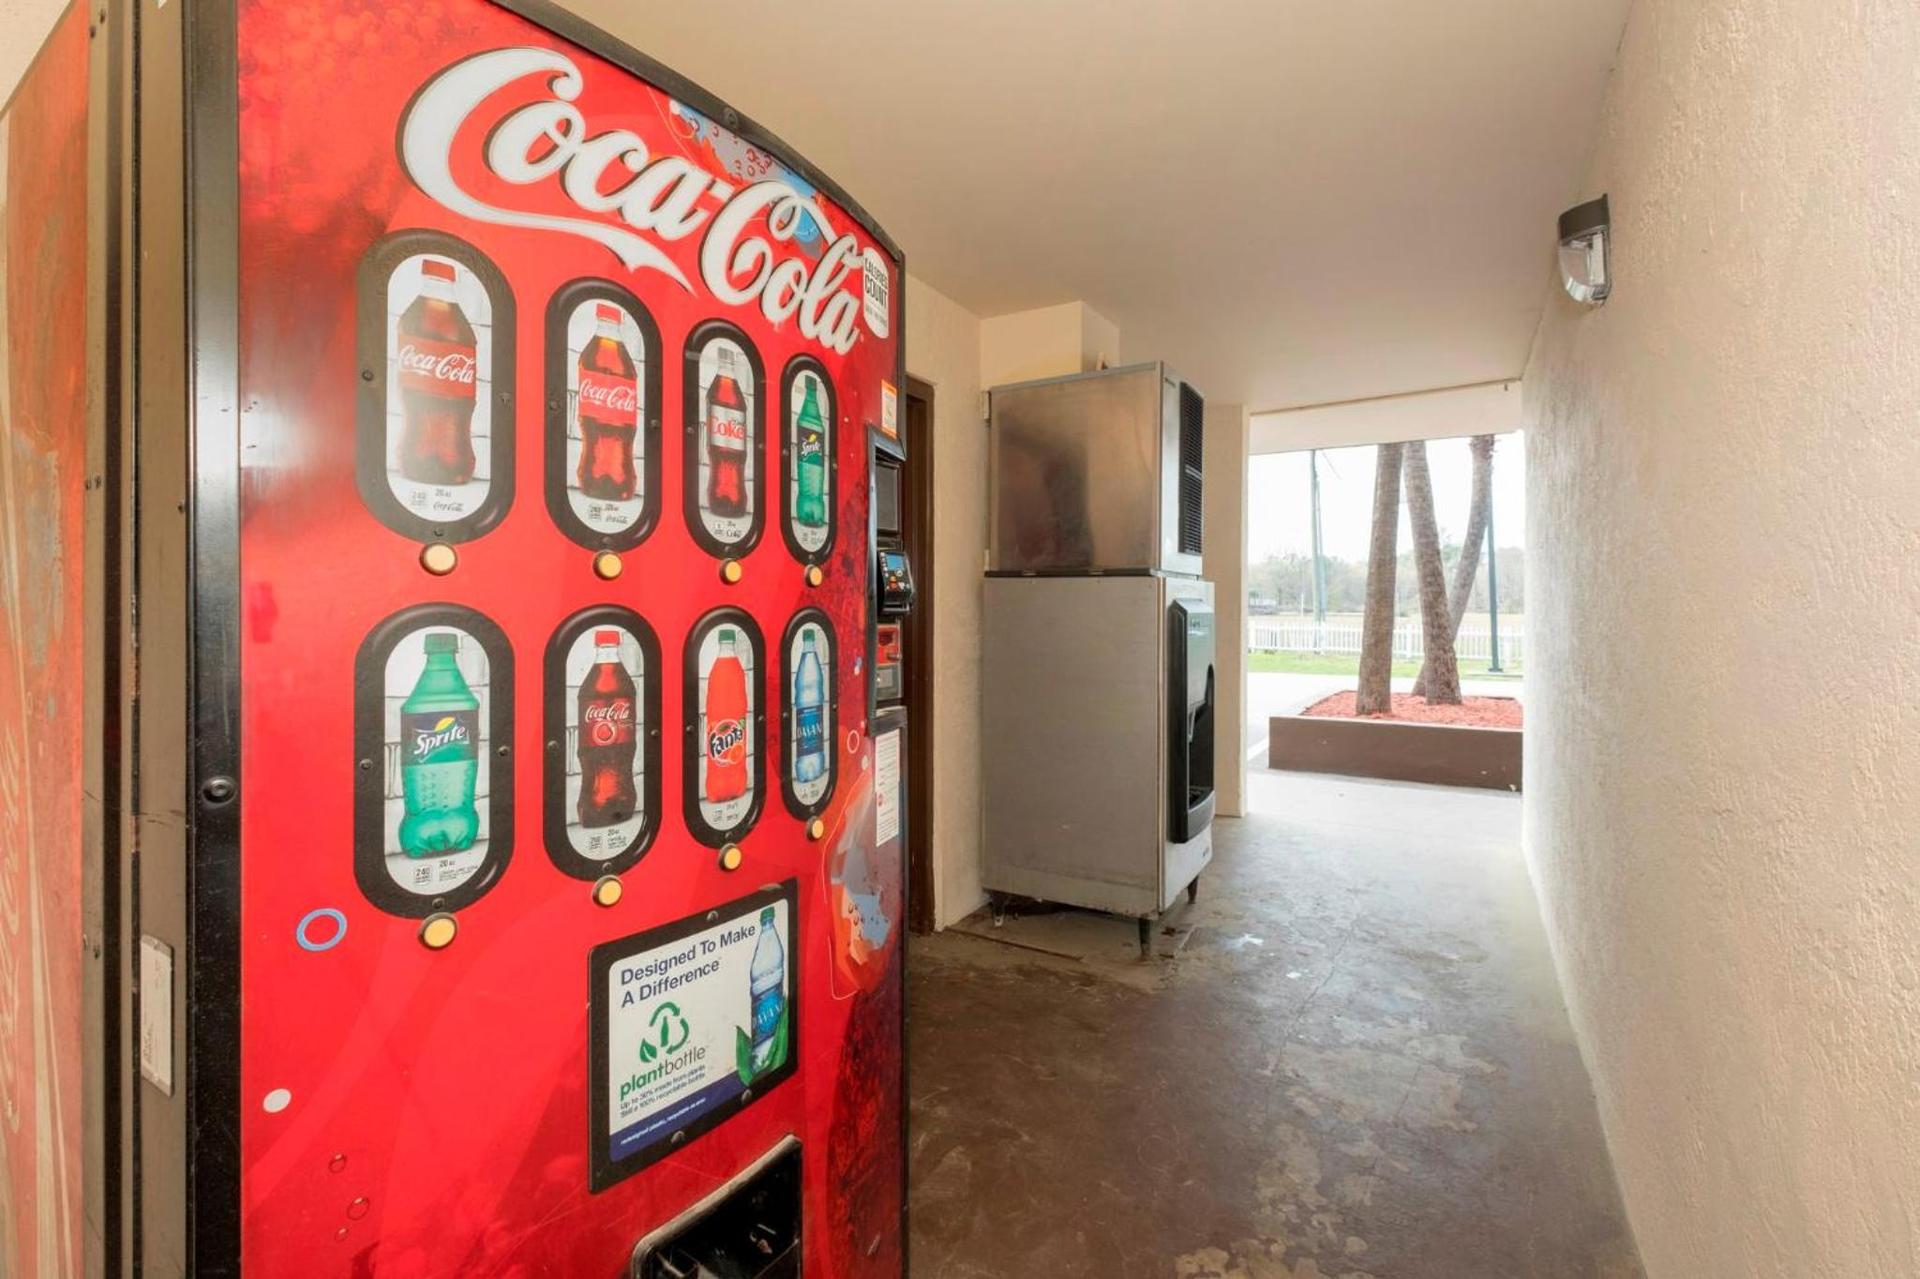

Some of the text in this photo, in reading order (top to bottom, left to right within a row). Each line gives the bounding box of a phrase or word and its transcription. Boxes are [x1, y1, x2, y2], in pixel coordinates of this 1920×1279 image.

[402, 47, 862, 355] Coca-Cola
[399, 345, 474, 384] Coca-Cola
[579, 378, 635, 412] Coca-Cola
[585, 701, 631, 723] Coca-Cola
[413, 724, 467, 755] Sprite
[621, 925, 756, 986] Designed To Make
[621, 959, 720, 1008] A Difference
[620, 1044, 706, 1101] plantbottle
